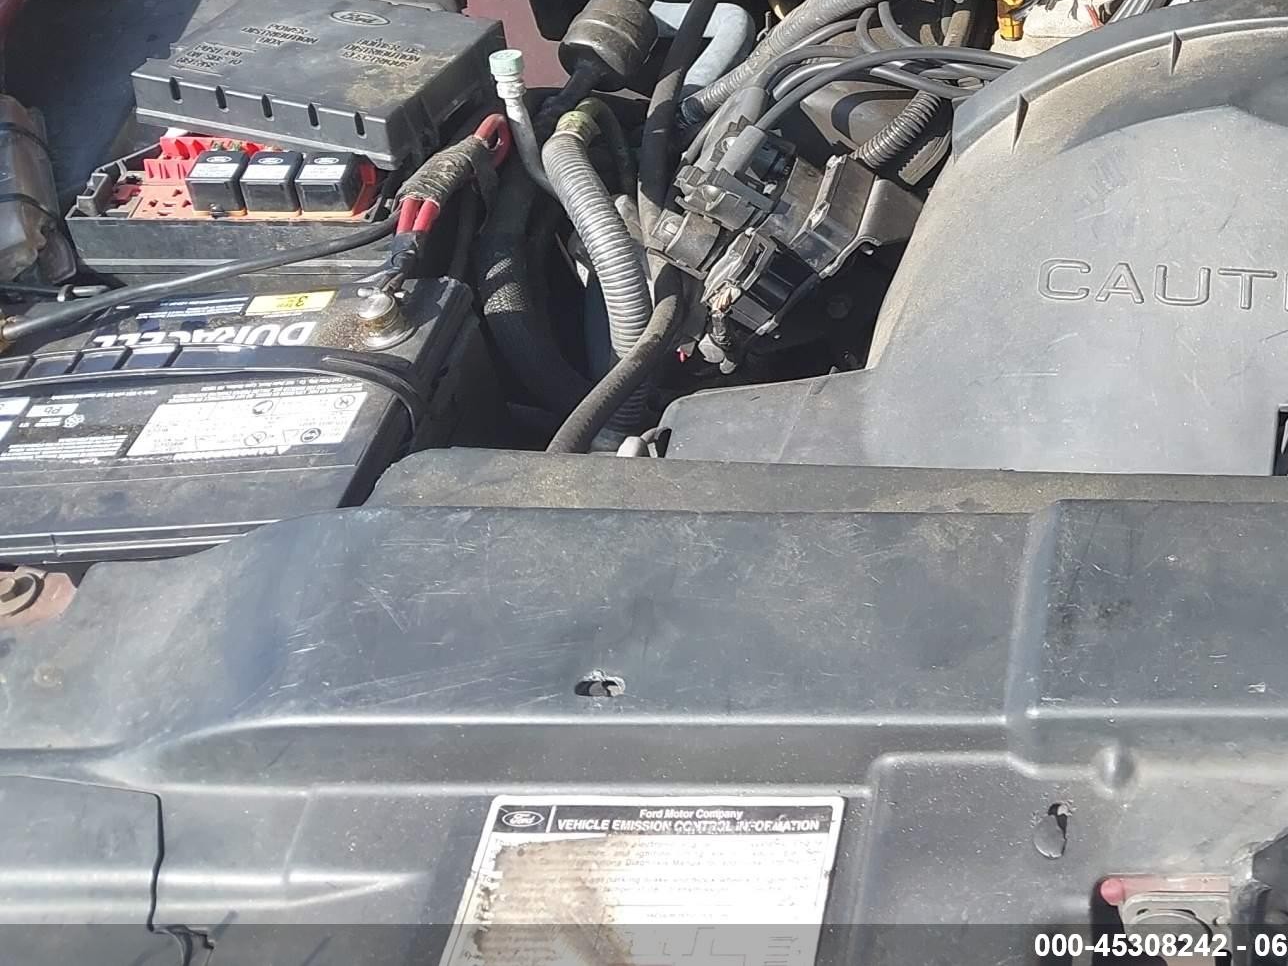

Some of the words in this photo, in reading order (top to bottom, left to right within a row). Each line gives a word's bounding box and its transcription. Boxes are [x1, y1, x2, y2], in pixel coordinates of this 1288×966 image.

[92, 321, 317, 348] DURACELL
[639, 809, 663, 819] Ford
[664, 809, 694, 819] Motor
[695, 809, 744, 820] Company
[557, 819, 609, 831] VEHICLE
[612, 819, 672, 832] EMISSION
[673, 820, 732, 833] CONTROL
[735, 820, 820, 833] INFORMATION
